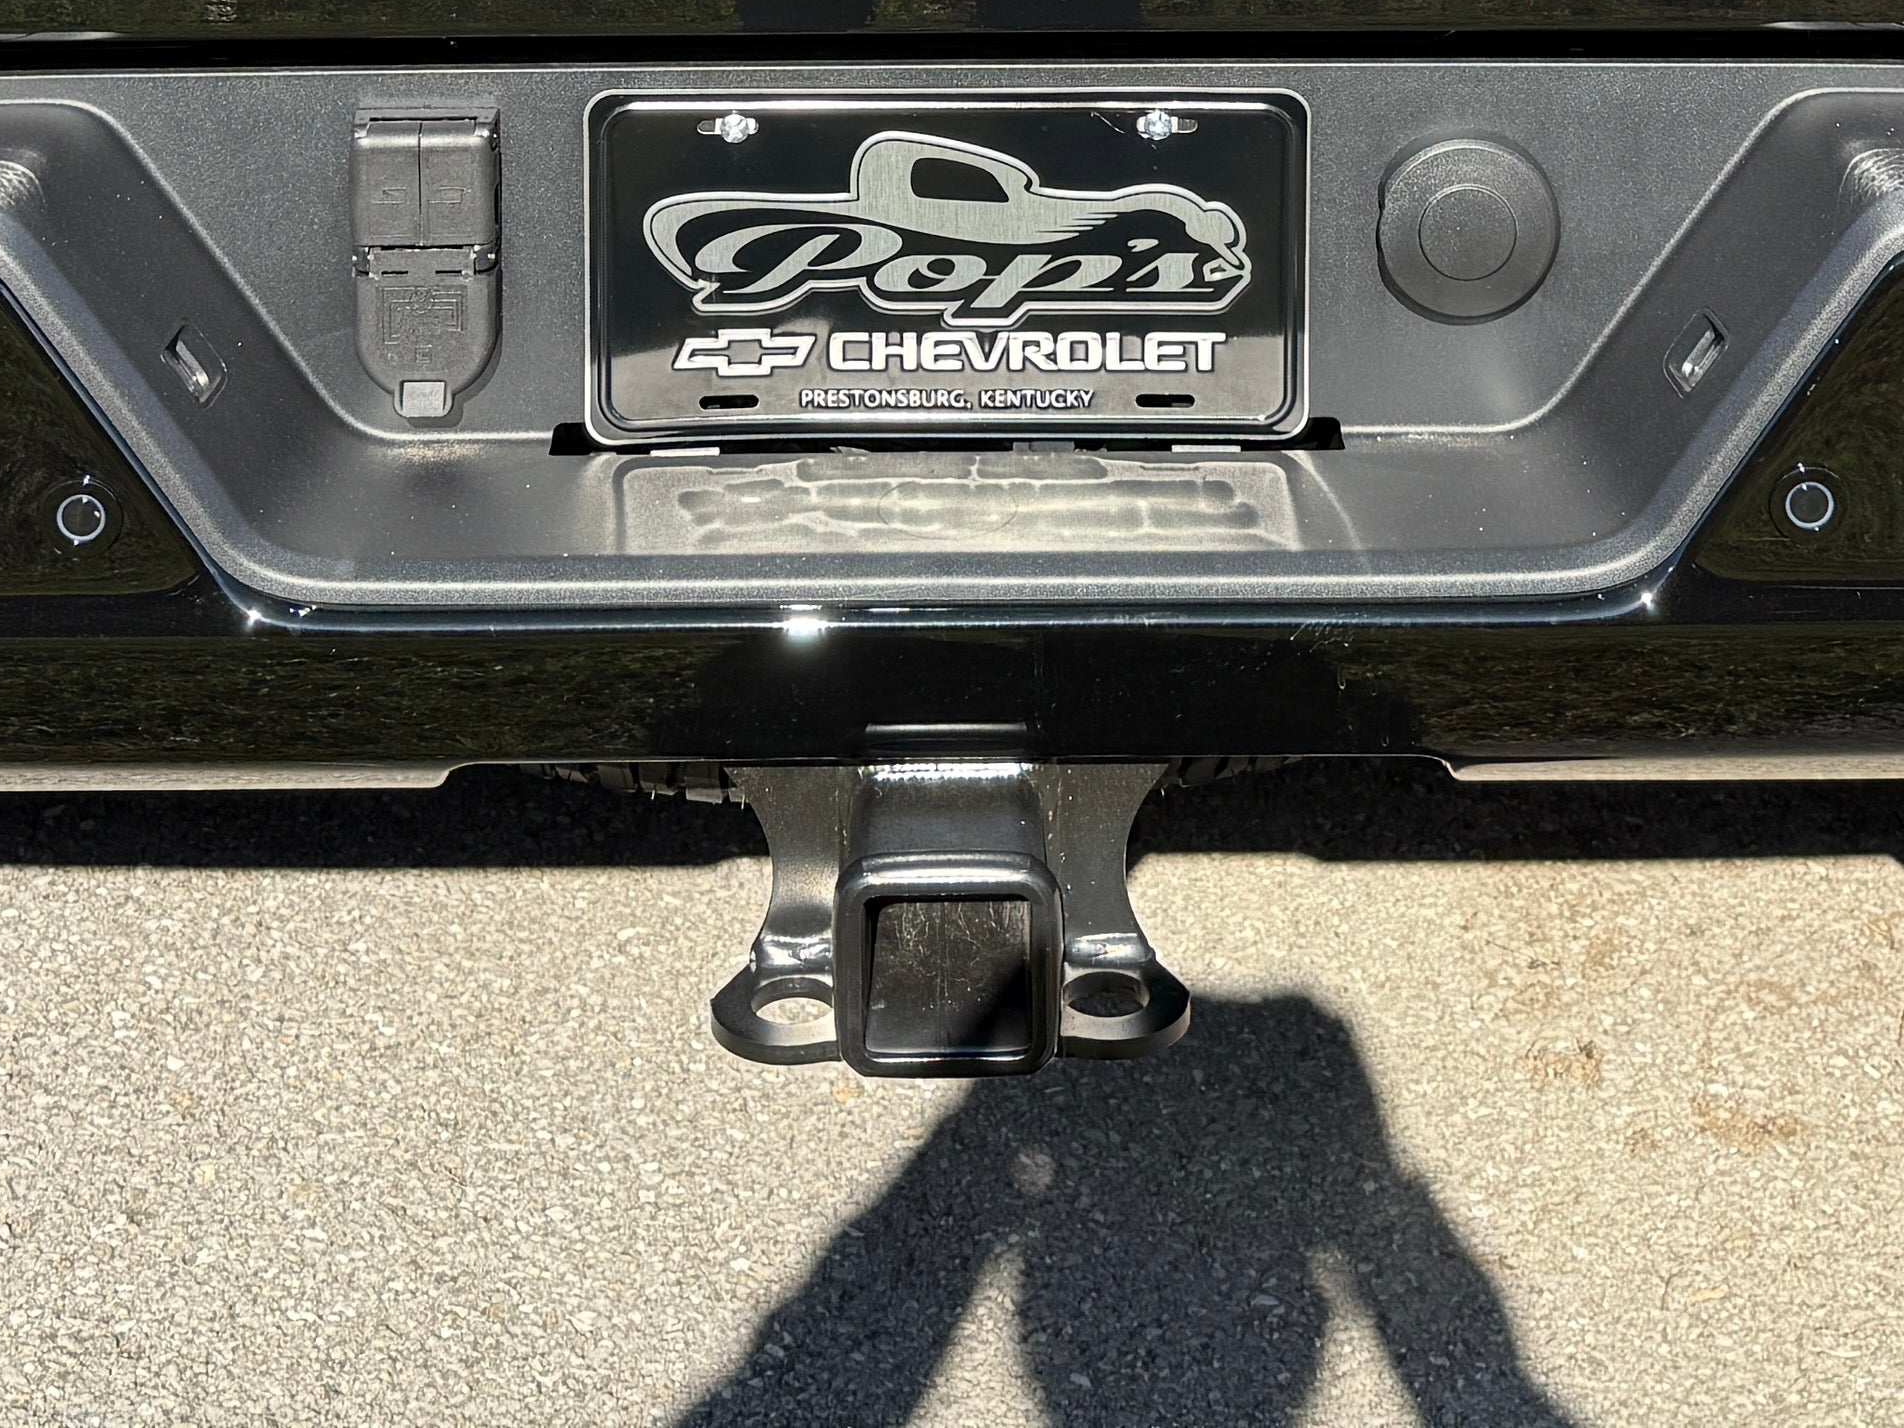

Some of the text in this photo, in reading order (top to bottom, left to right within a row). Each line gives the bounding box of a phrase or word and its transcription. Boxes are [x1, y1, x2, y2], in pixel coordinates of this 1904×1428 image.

[696, 222, 1200, 310] Pop's
[828, 331, 1227, 372] CHEVROLET
[800, 388, 1095, 410] PRESTONSBURG, KENTUCKY
